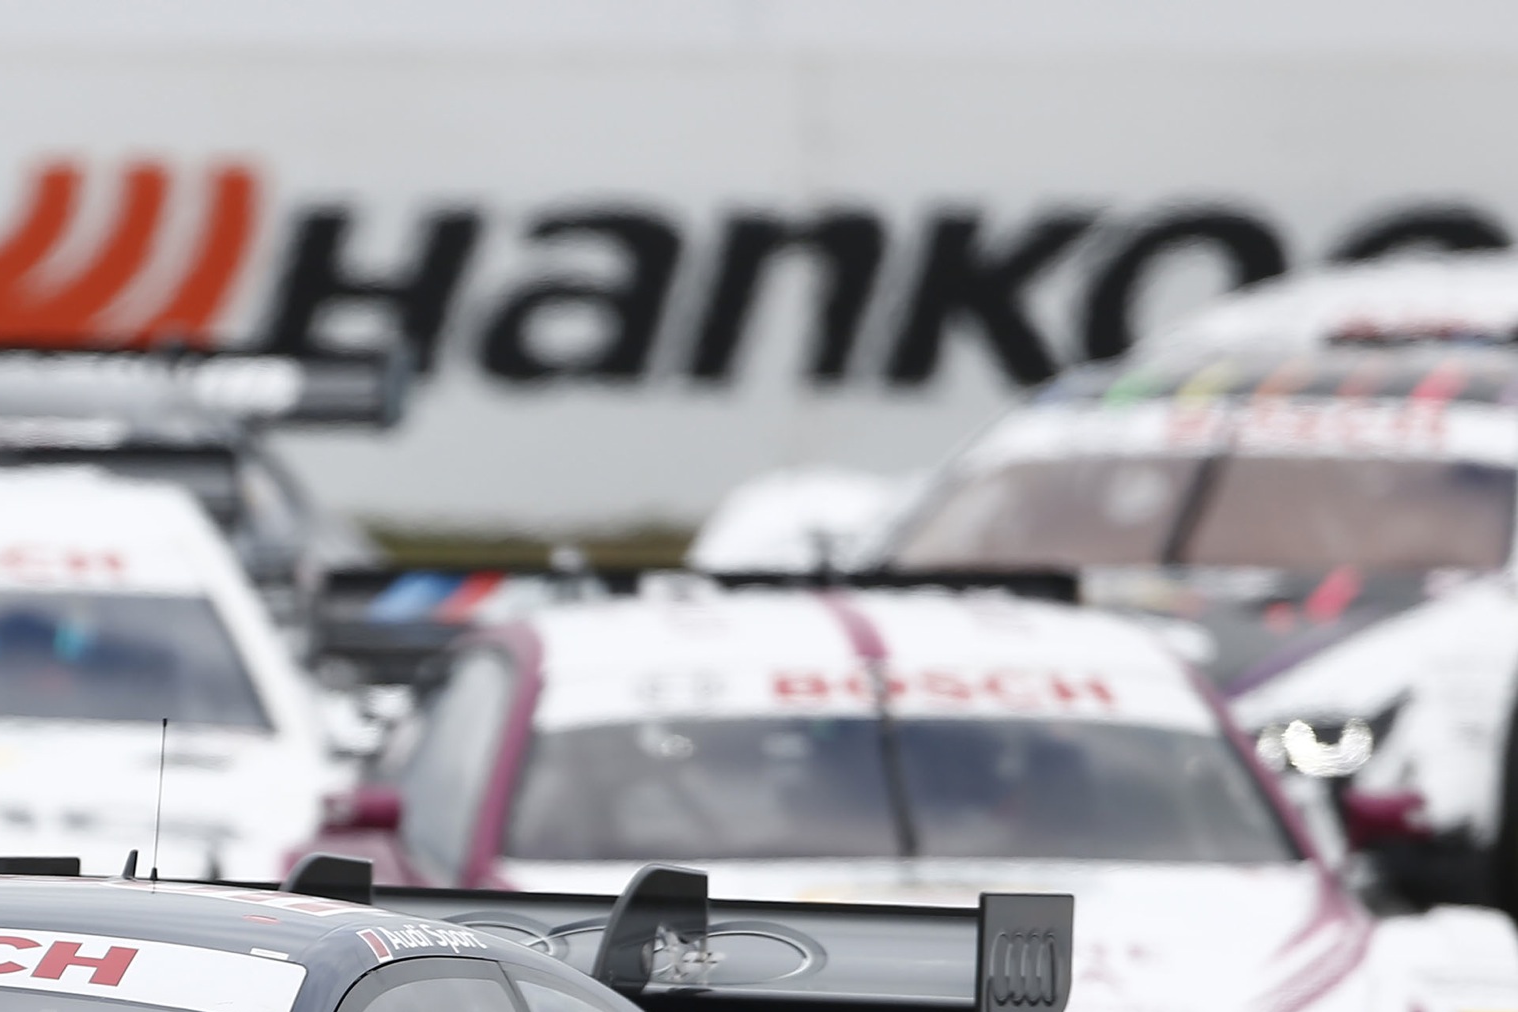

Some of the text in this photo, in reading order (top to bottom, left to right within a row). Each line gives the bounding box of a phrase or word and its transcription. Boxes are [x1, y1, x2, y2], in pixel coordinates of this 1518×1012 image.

[768, 668, 1116, 708] BOSCH
[378, 922, 488, 954] Audi Sport
